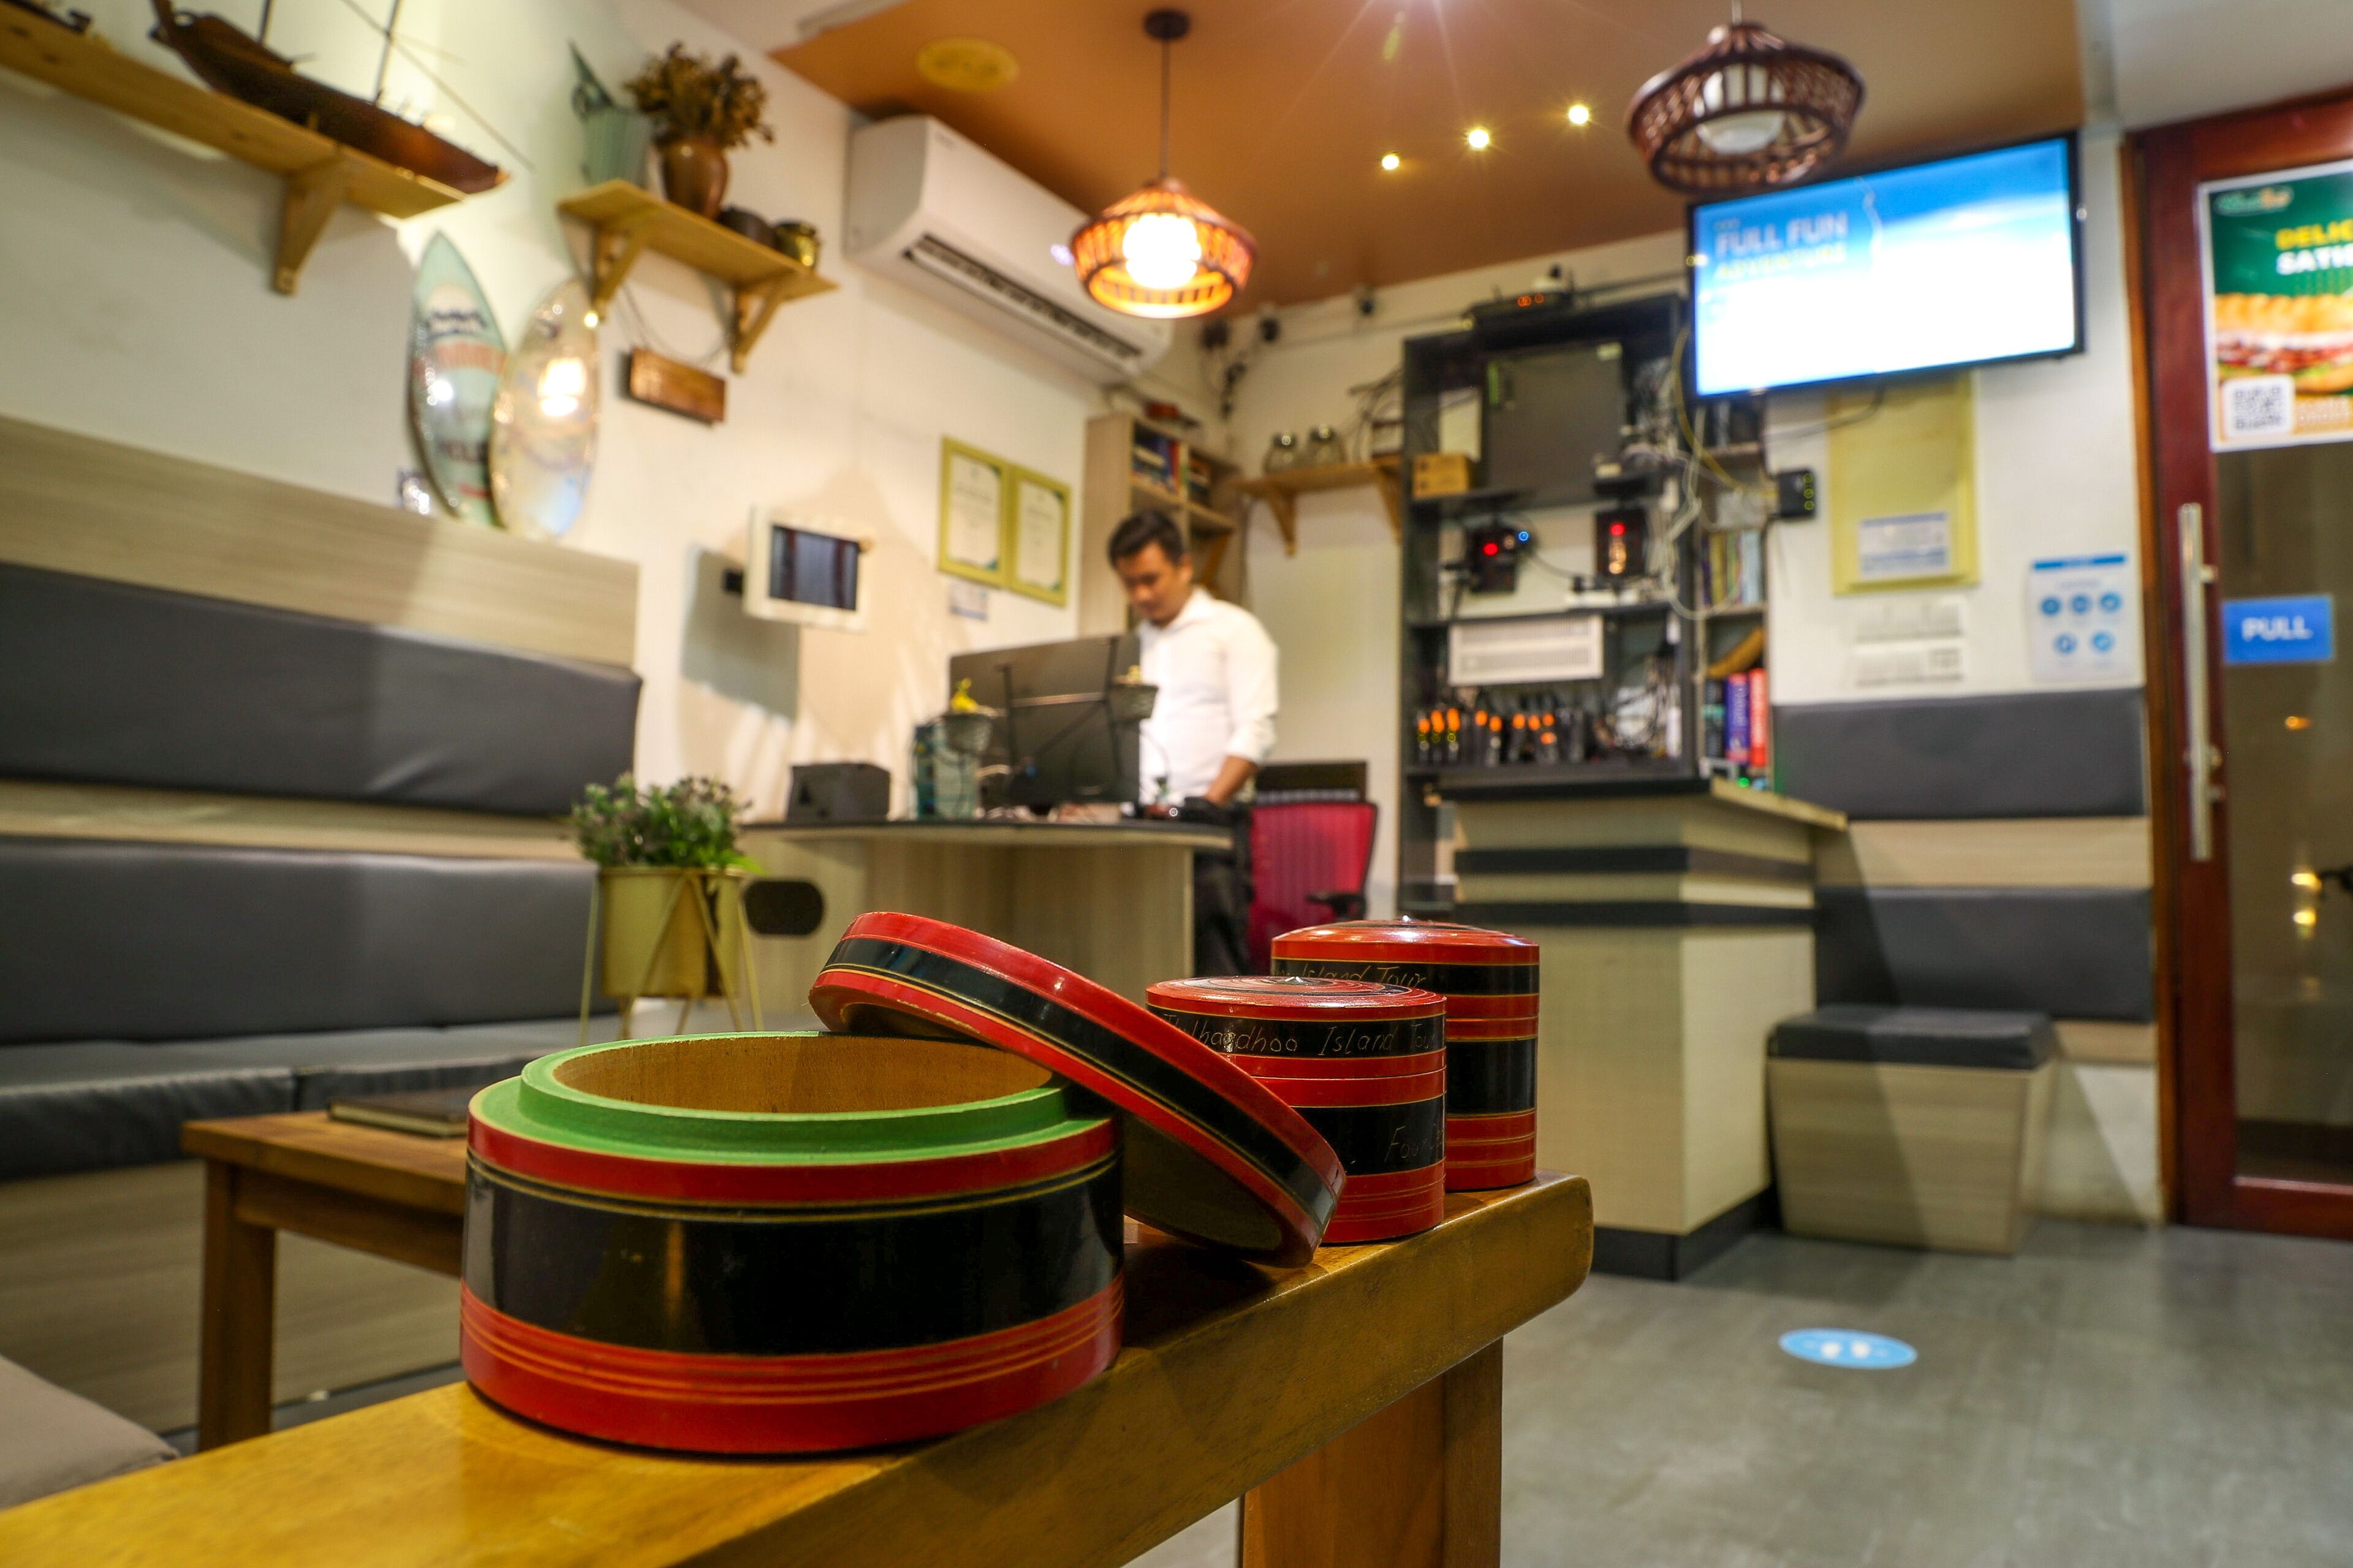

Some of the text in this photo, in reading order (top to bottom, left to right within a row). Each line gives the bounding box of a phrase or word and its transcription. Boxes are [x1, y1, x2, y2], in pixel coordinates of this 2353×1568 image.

[1715, 224, 1783, 259] FULL
[1786, 211, 1849, 244] FUN
[2241, 615, 2314, 642] PULL
[1164, 1013, 1298, 1052] Tlhadhoo
[1317, 1026, 1399, 1056] Island
